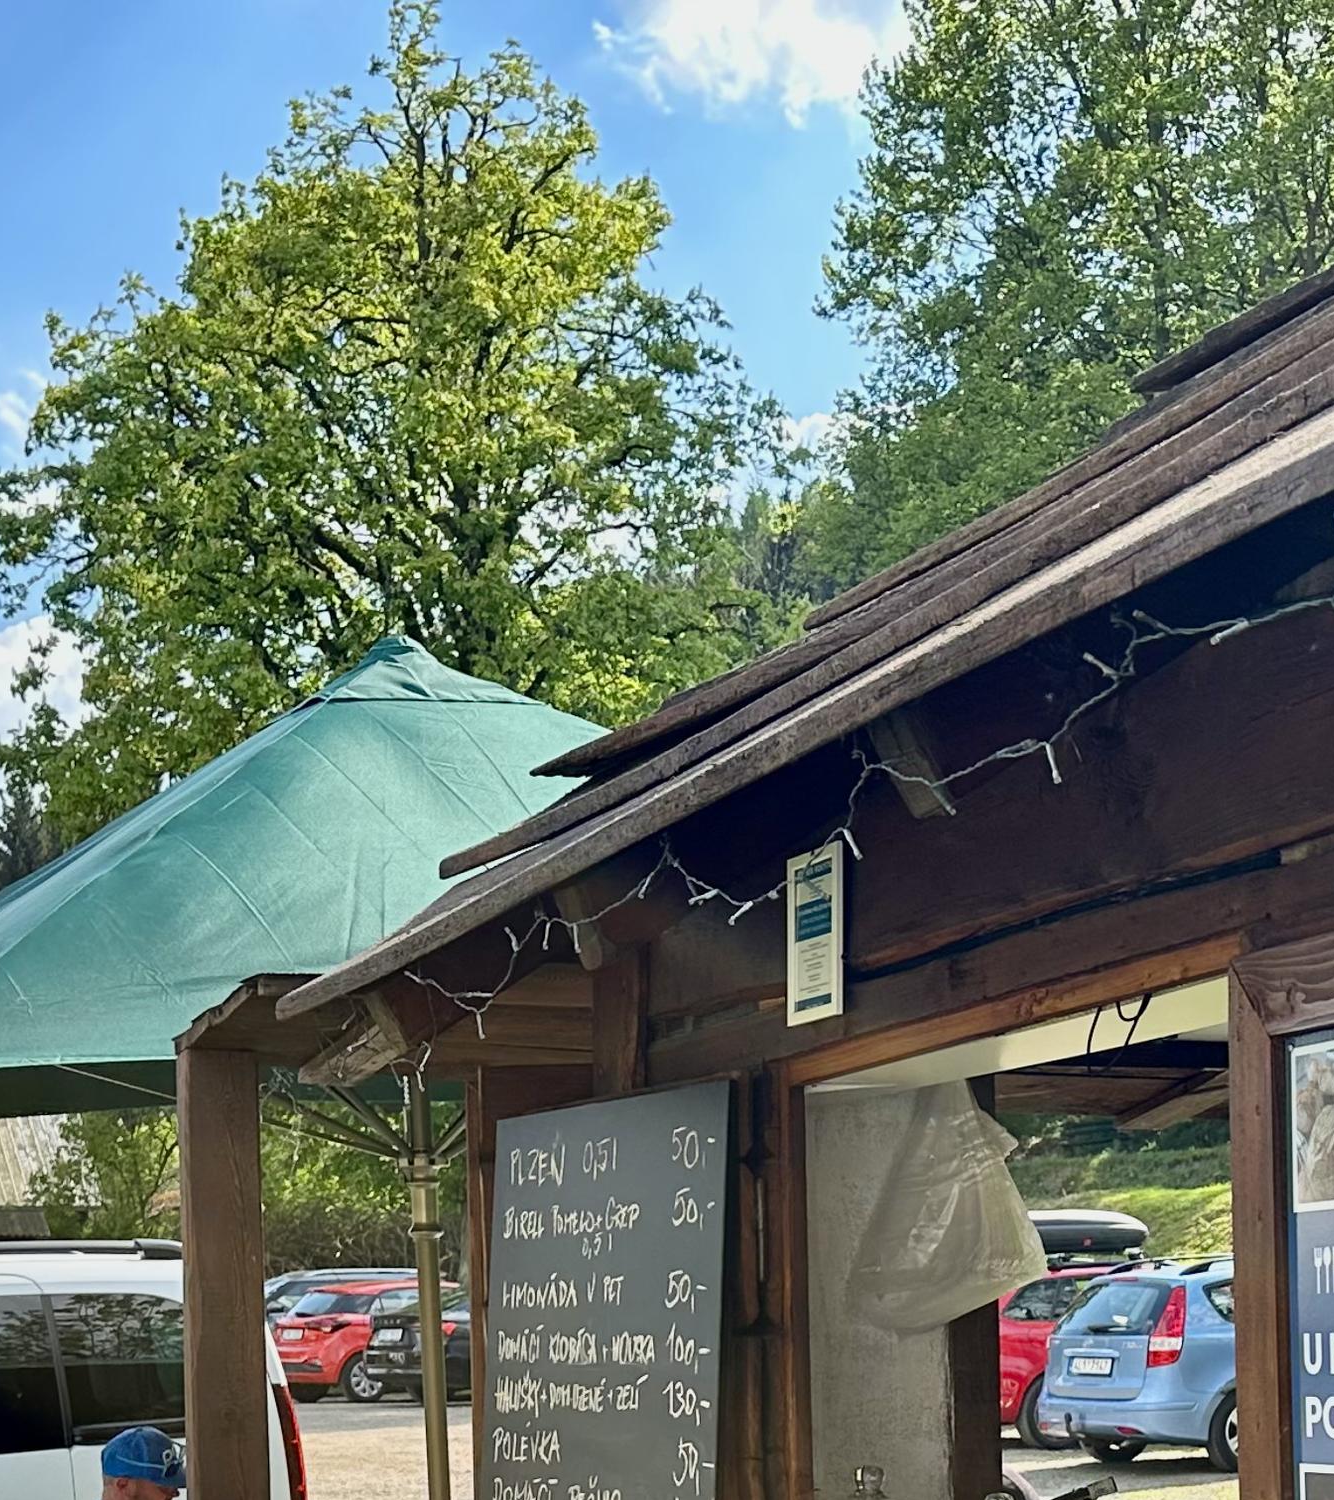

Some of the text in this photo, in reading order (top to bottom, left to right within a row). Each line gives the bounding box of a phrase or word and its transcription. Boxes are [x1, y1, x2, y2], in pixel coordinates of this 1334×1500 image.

[671, 1126, 716, 1169] 50,-
[671, 1187, 716, 1231] 50,-
[502, 1269, 707, 1313] LIMONÁDA V PET 50,-
[497, 1324, 544, 1364] DOMÁCÍ
[666, 1322, 711, 1374] 100,-
[1303, 1332, 1323, 1376] U
[662, 1380, 710, 1426] 130,-
[493, 1421, 561, 1465] POLÉVKA
